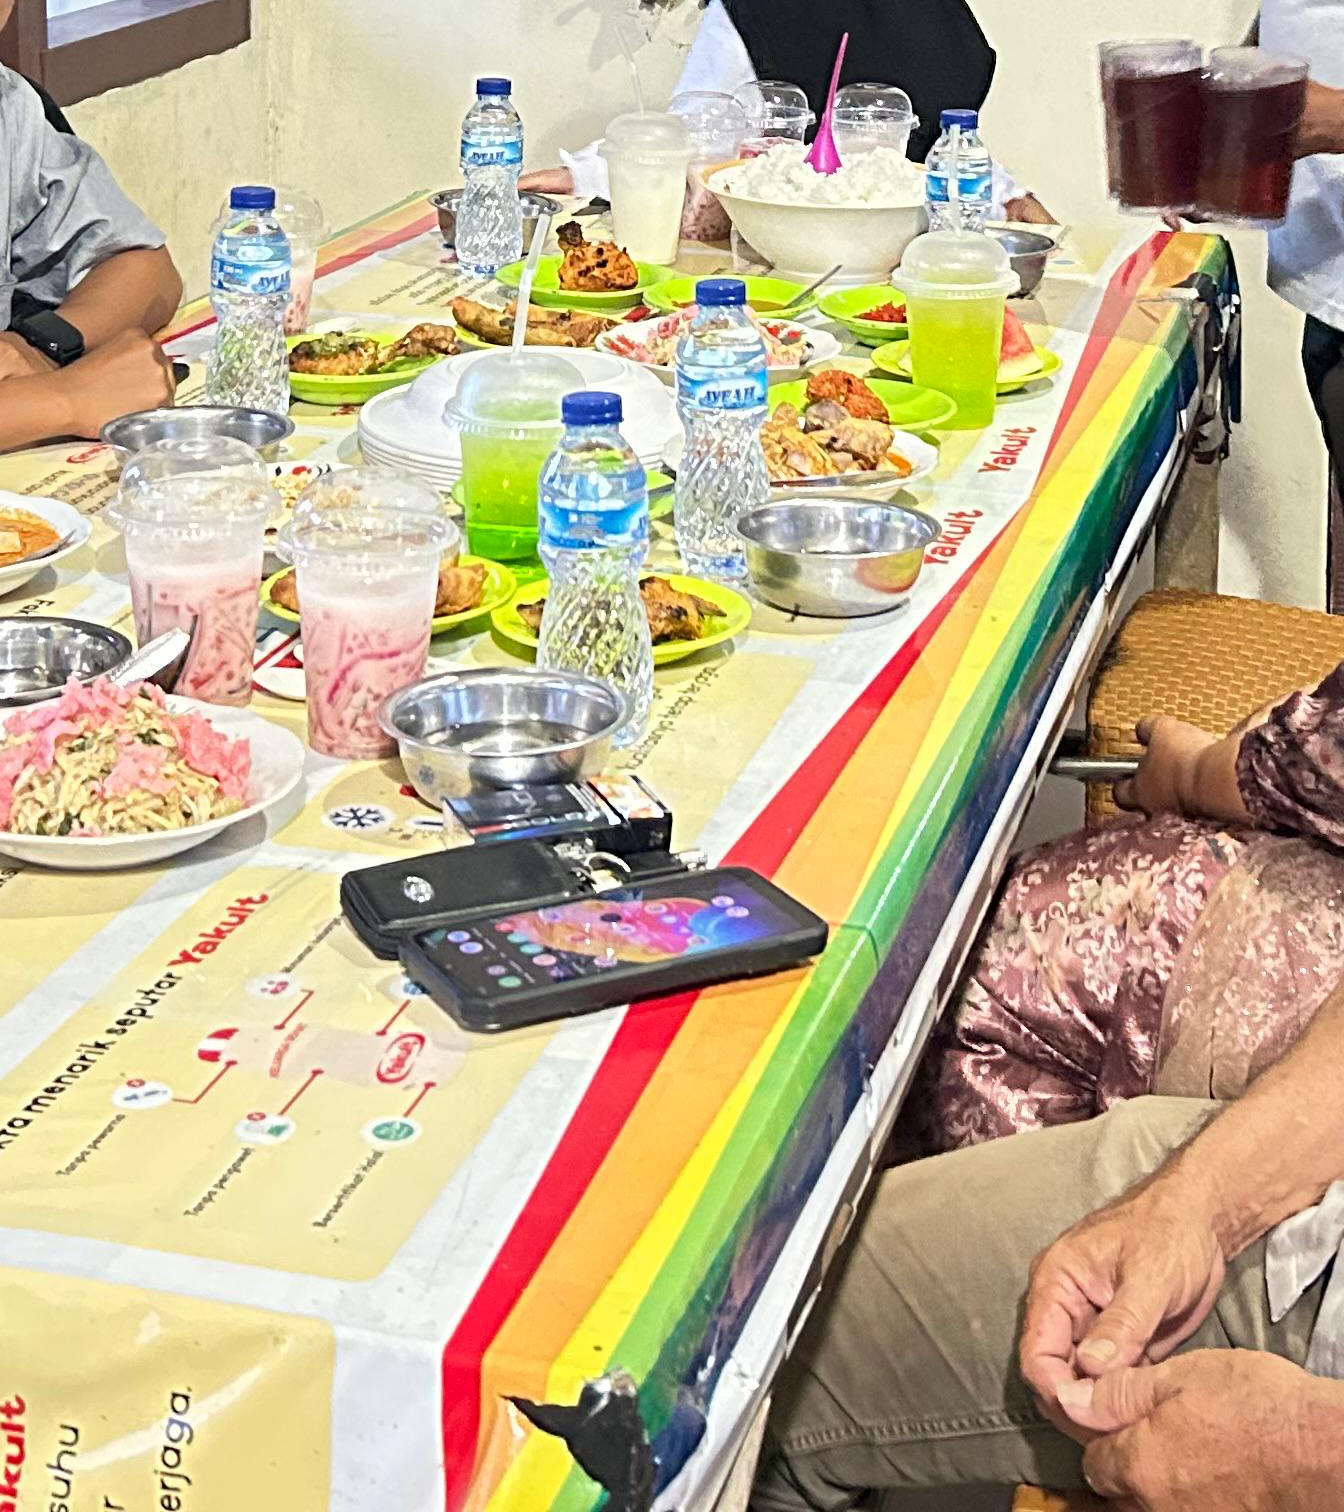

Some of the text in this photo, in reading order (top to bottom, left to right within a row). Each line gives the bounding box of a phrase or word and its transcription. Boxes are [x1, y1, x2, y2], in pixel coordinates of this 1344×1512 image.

[978, 426, 1038, 474] Yakult
[923, 510, 984, 565] Yakult
[23, 1037, 118, 1115] menarik
[105, 971, 184, 1036] seputar
[166, 893, 270, 967] Yakult
[152, 1386, 195, 1512] erjaga.
